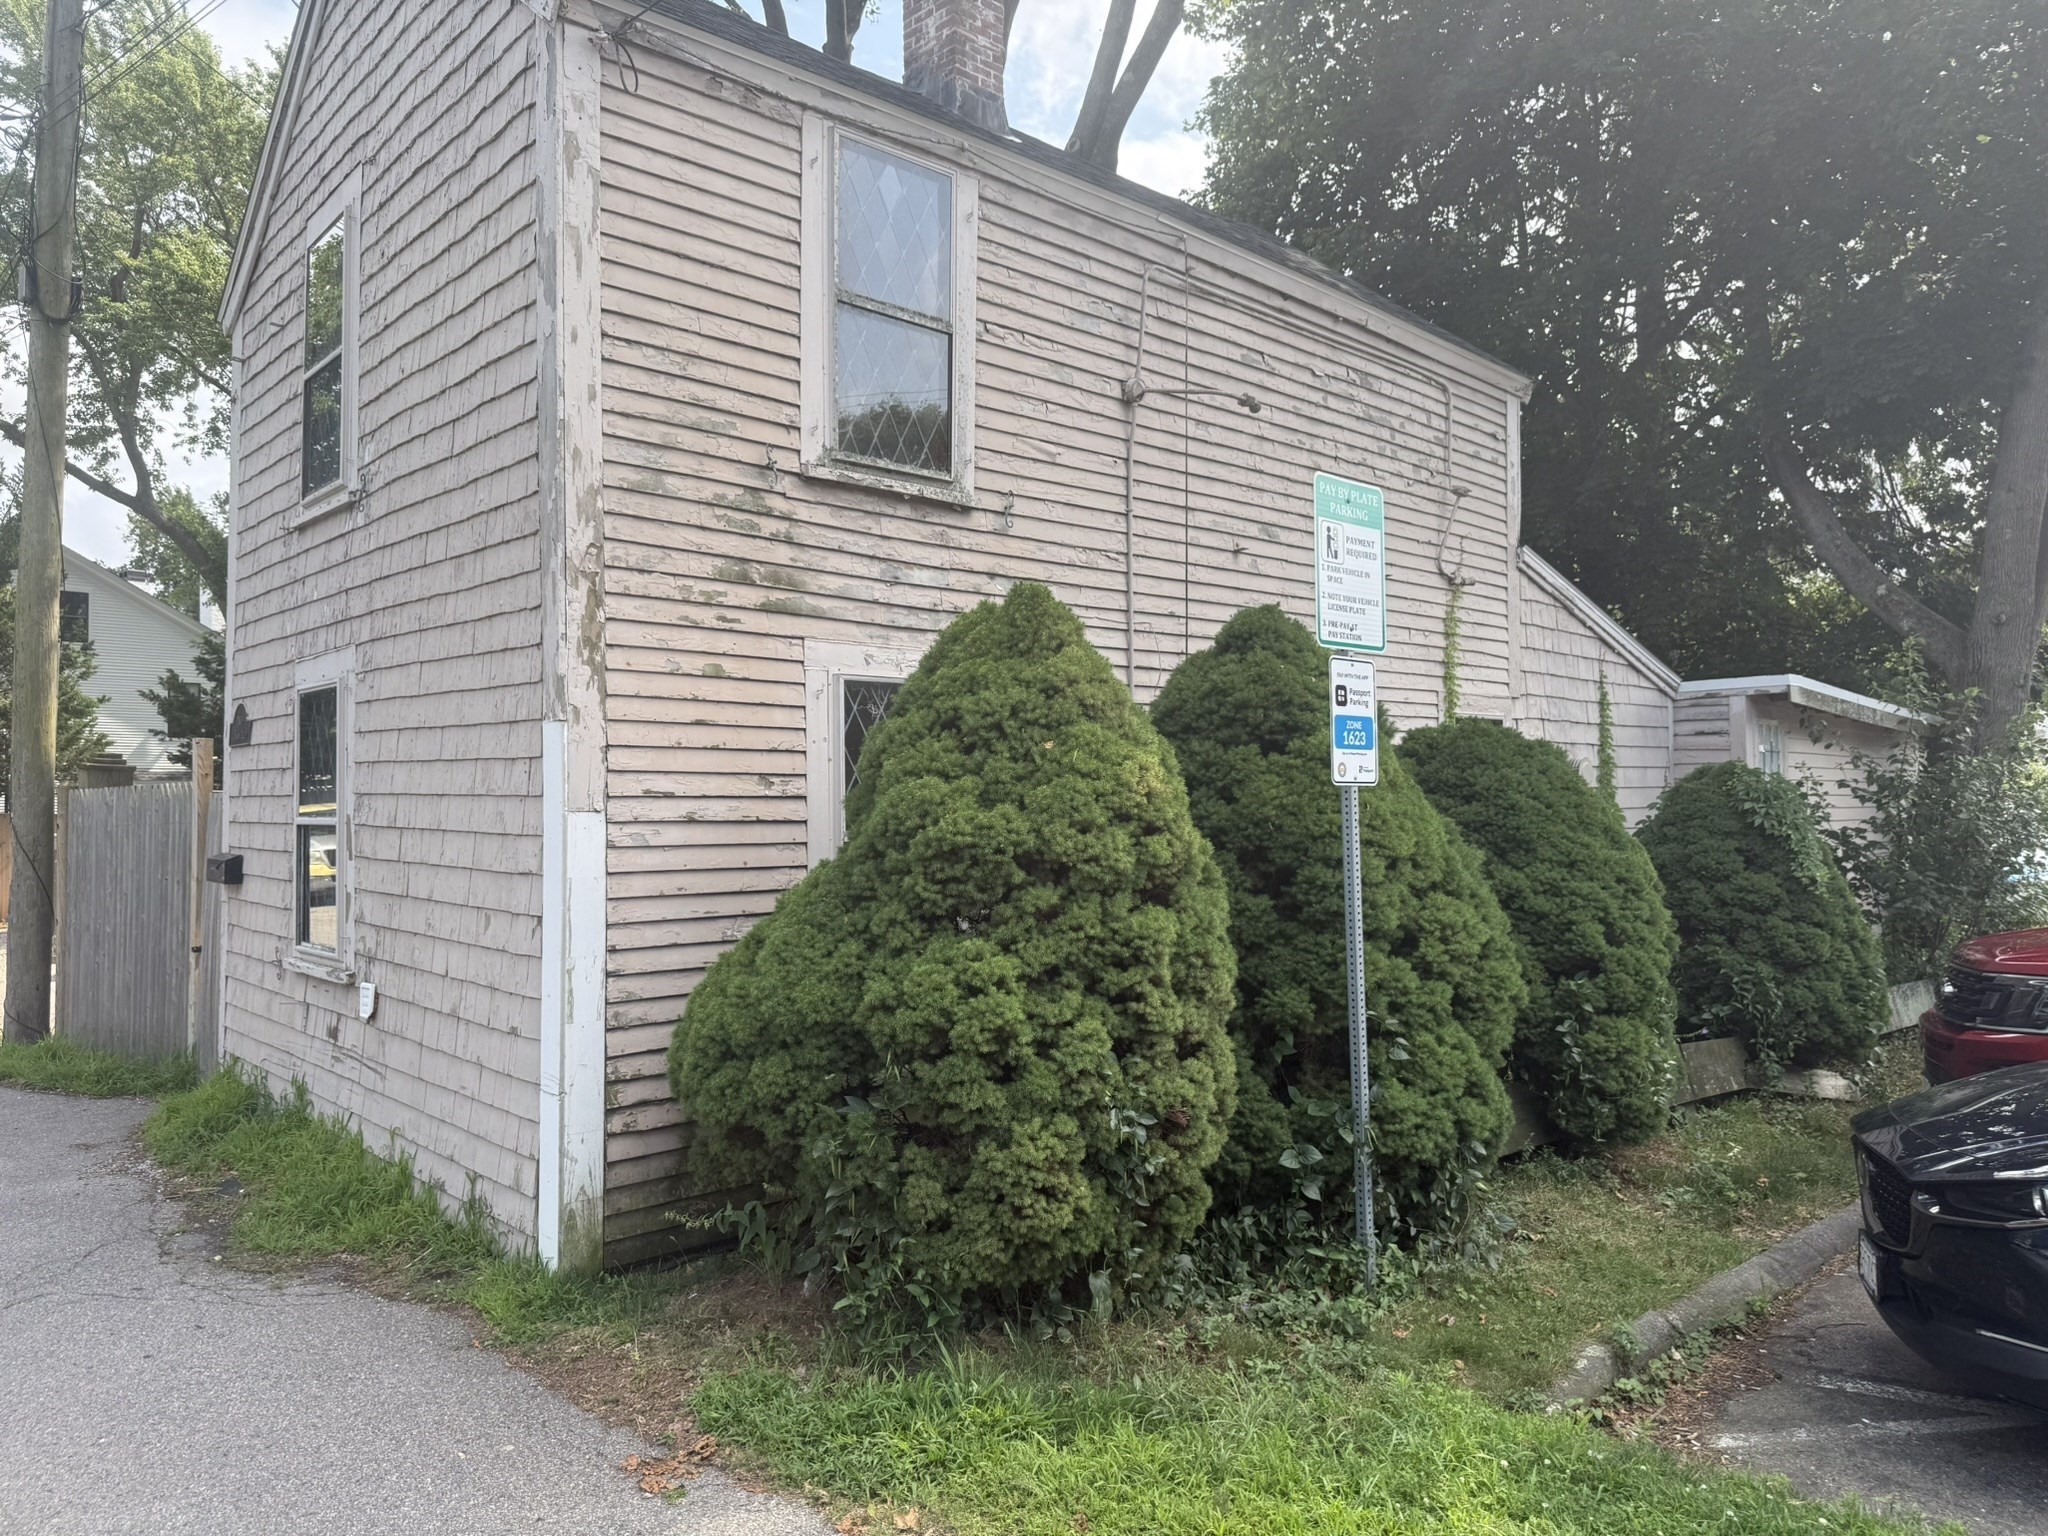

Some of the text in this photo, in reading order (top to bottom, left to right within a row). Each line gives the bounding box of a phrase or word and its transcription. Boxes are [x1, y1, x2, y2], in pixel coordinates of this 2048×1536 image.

[1319, 481, 1378, 507] PAY BY PLATE
[1330, 502, 1368, 521] PARKING
[1346, 535, 1375, 549] PAYMENT
[1346, 548, 1377, 561] REQUIRED
[1322, 563, 1370, 579] 1. PARK VEHICLE IN
[1327, 575, 1343, 585] SPACE
[1322, 591, 1379, 607] 2. NOTE YOUR VEHICLE
[1328, 603, 1366, 615] LICENSE PLATE
[1328, 630, 1362, 642] PAY STATION
[1349, 688, 1371, 697] Passport
[1349, 698, 1369, 708] Parking
[1346, 720, 1362, 730] ZONE
[1342, 730, 1366, 746] 1623
